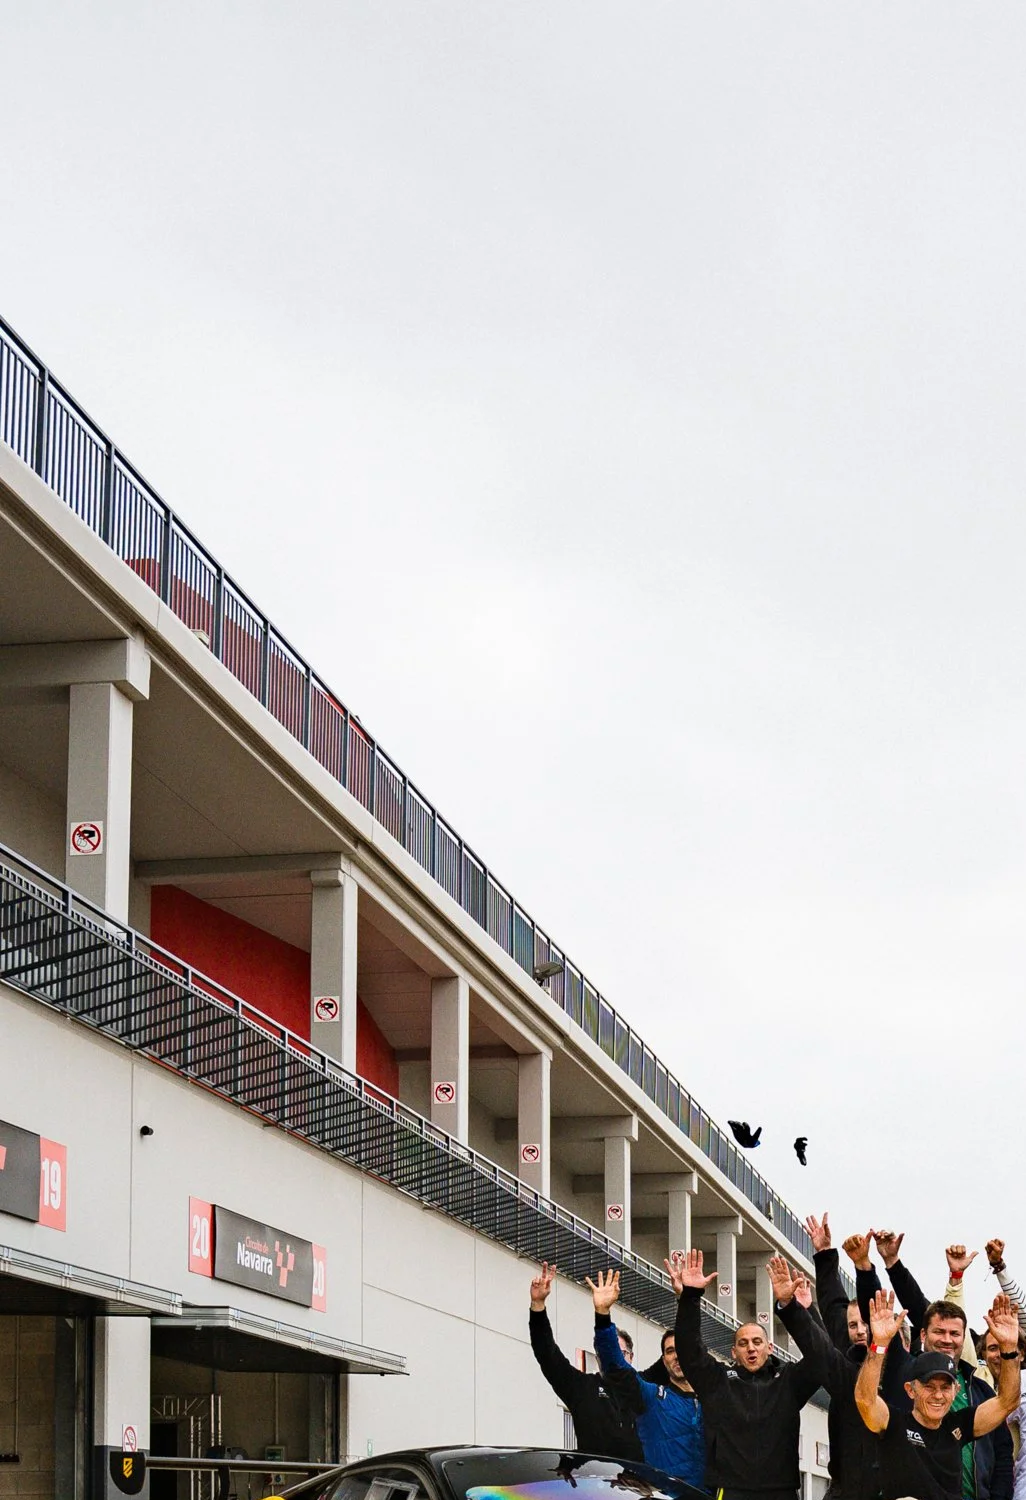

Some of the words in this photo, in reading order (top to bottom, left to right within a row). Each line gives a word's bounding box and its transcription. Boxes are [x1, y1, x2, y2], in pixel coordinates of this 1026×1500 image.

[42, 1157, 61, 1210] 19
[192, 1214, 209, 1259] 20
[236, 1241, 273, 1276] Navarra
[312, 1257, 325, 1297] 20
